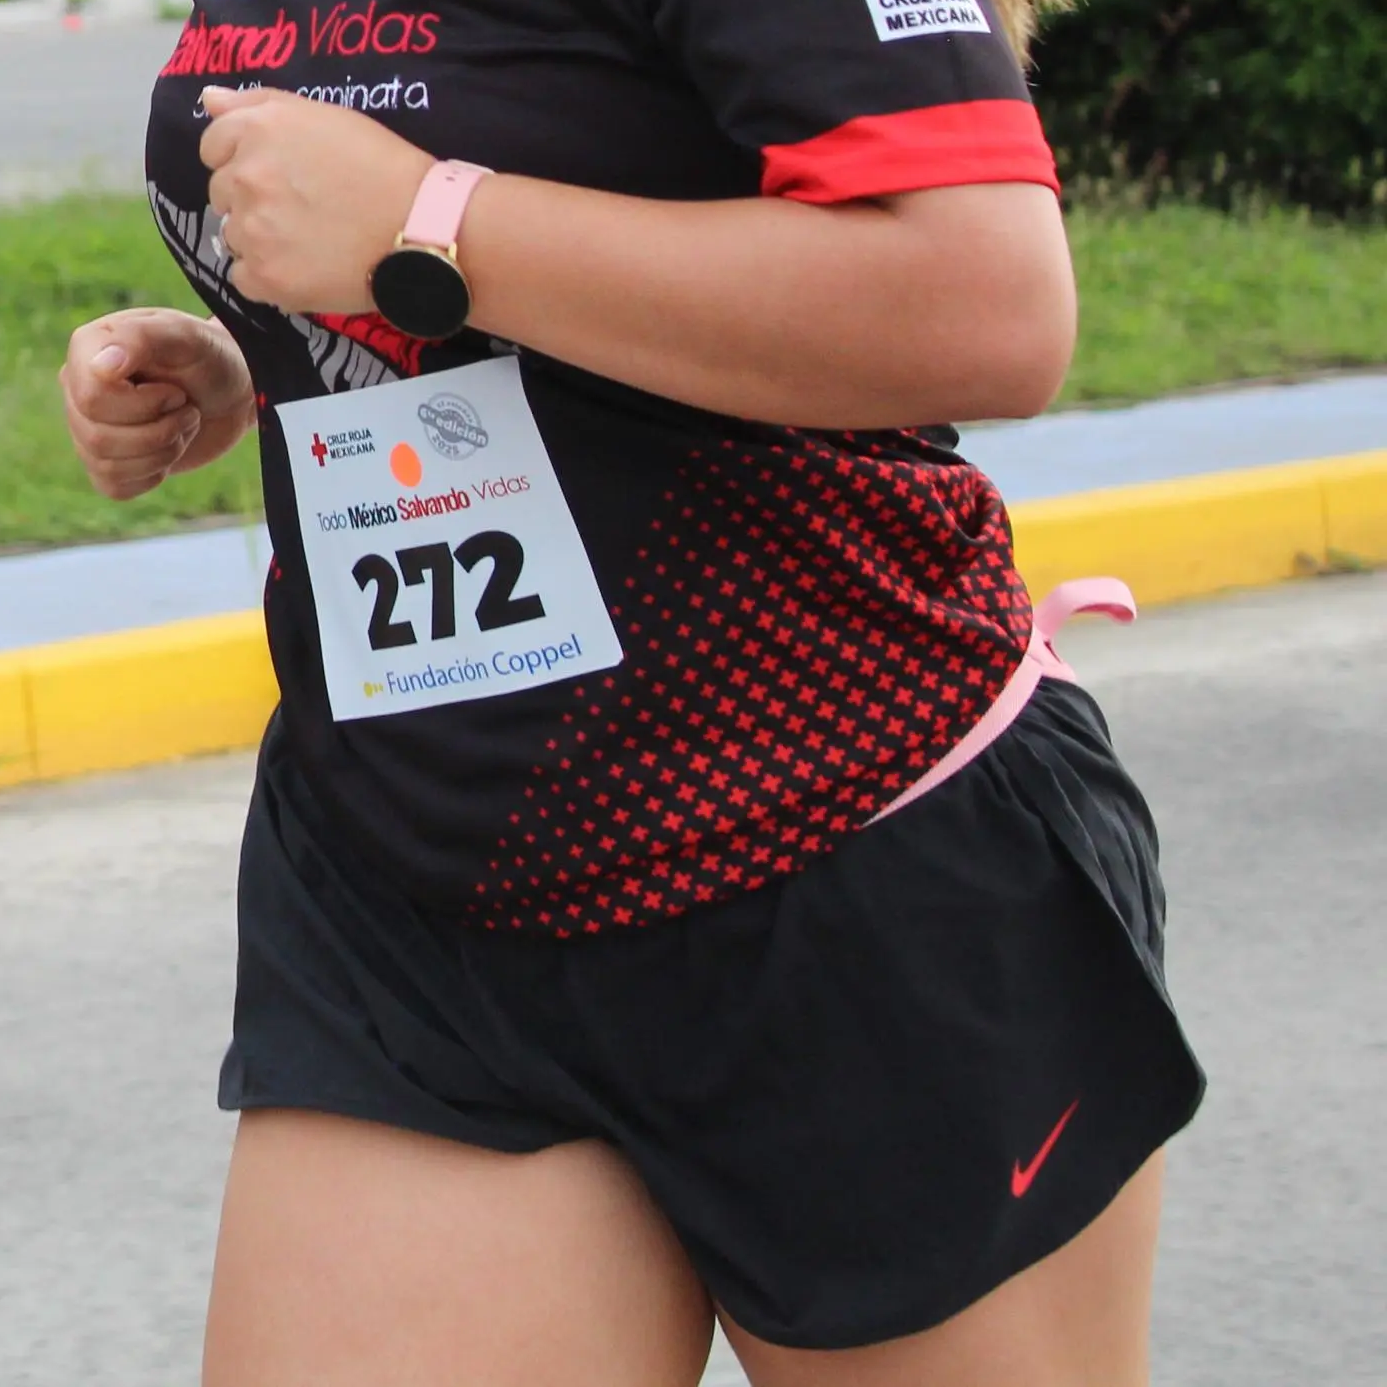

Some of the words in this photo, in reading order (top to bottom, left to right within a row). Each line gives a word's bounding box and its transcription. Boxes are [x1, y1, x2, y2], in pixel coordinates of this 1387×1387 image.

[885, 8, 980, 31] MEXICANA
[327, 431, 347, 446] CRUZ
[348, 428, 373, 443] ROJA
[329, 442, 376, 459] MEXICANA
[316, 510, 347, 532] Todo
[348, 502, 397, 530] México
[397, 487, 471, 522] Salvando
[471, 474, 531, 502] Vidas
[351, 530, 546, 651] 272
[386, 658, 490, 695] Fundación
[491, 633, 582, 676] Coppel
